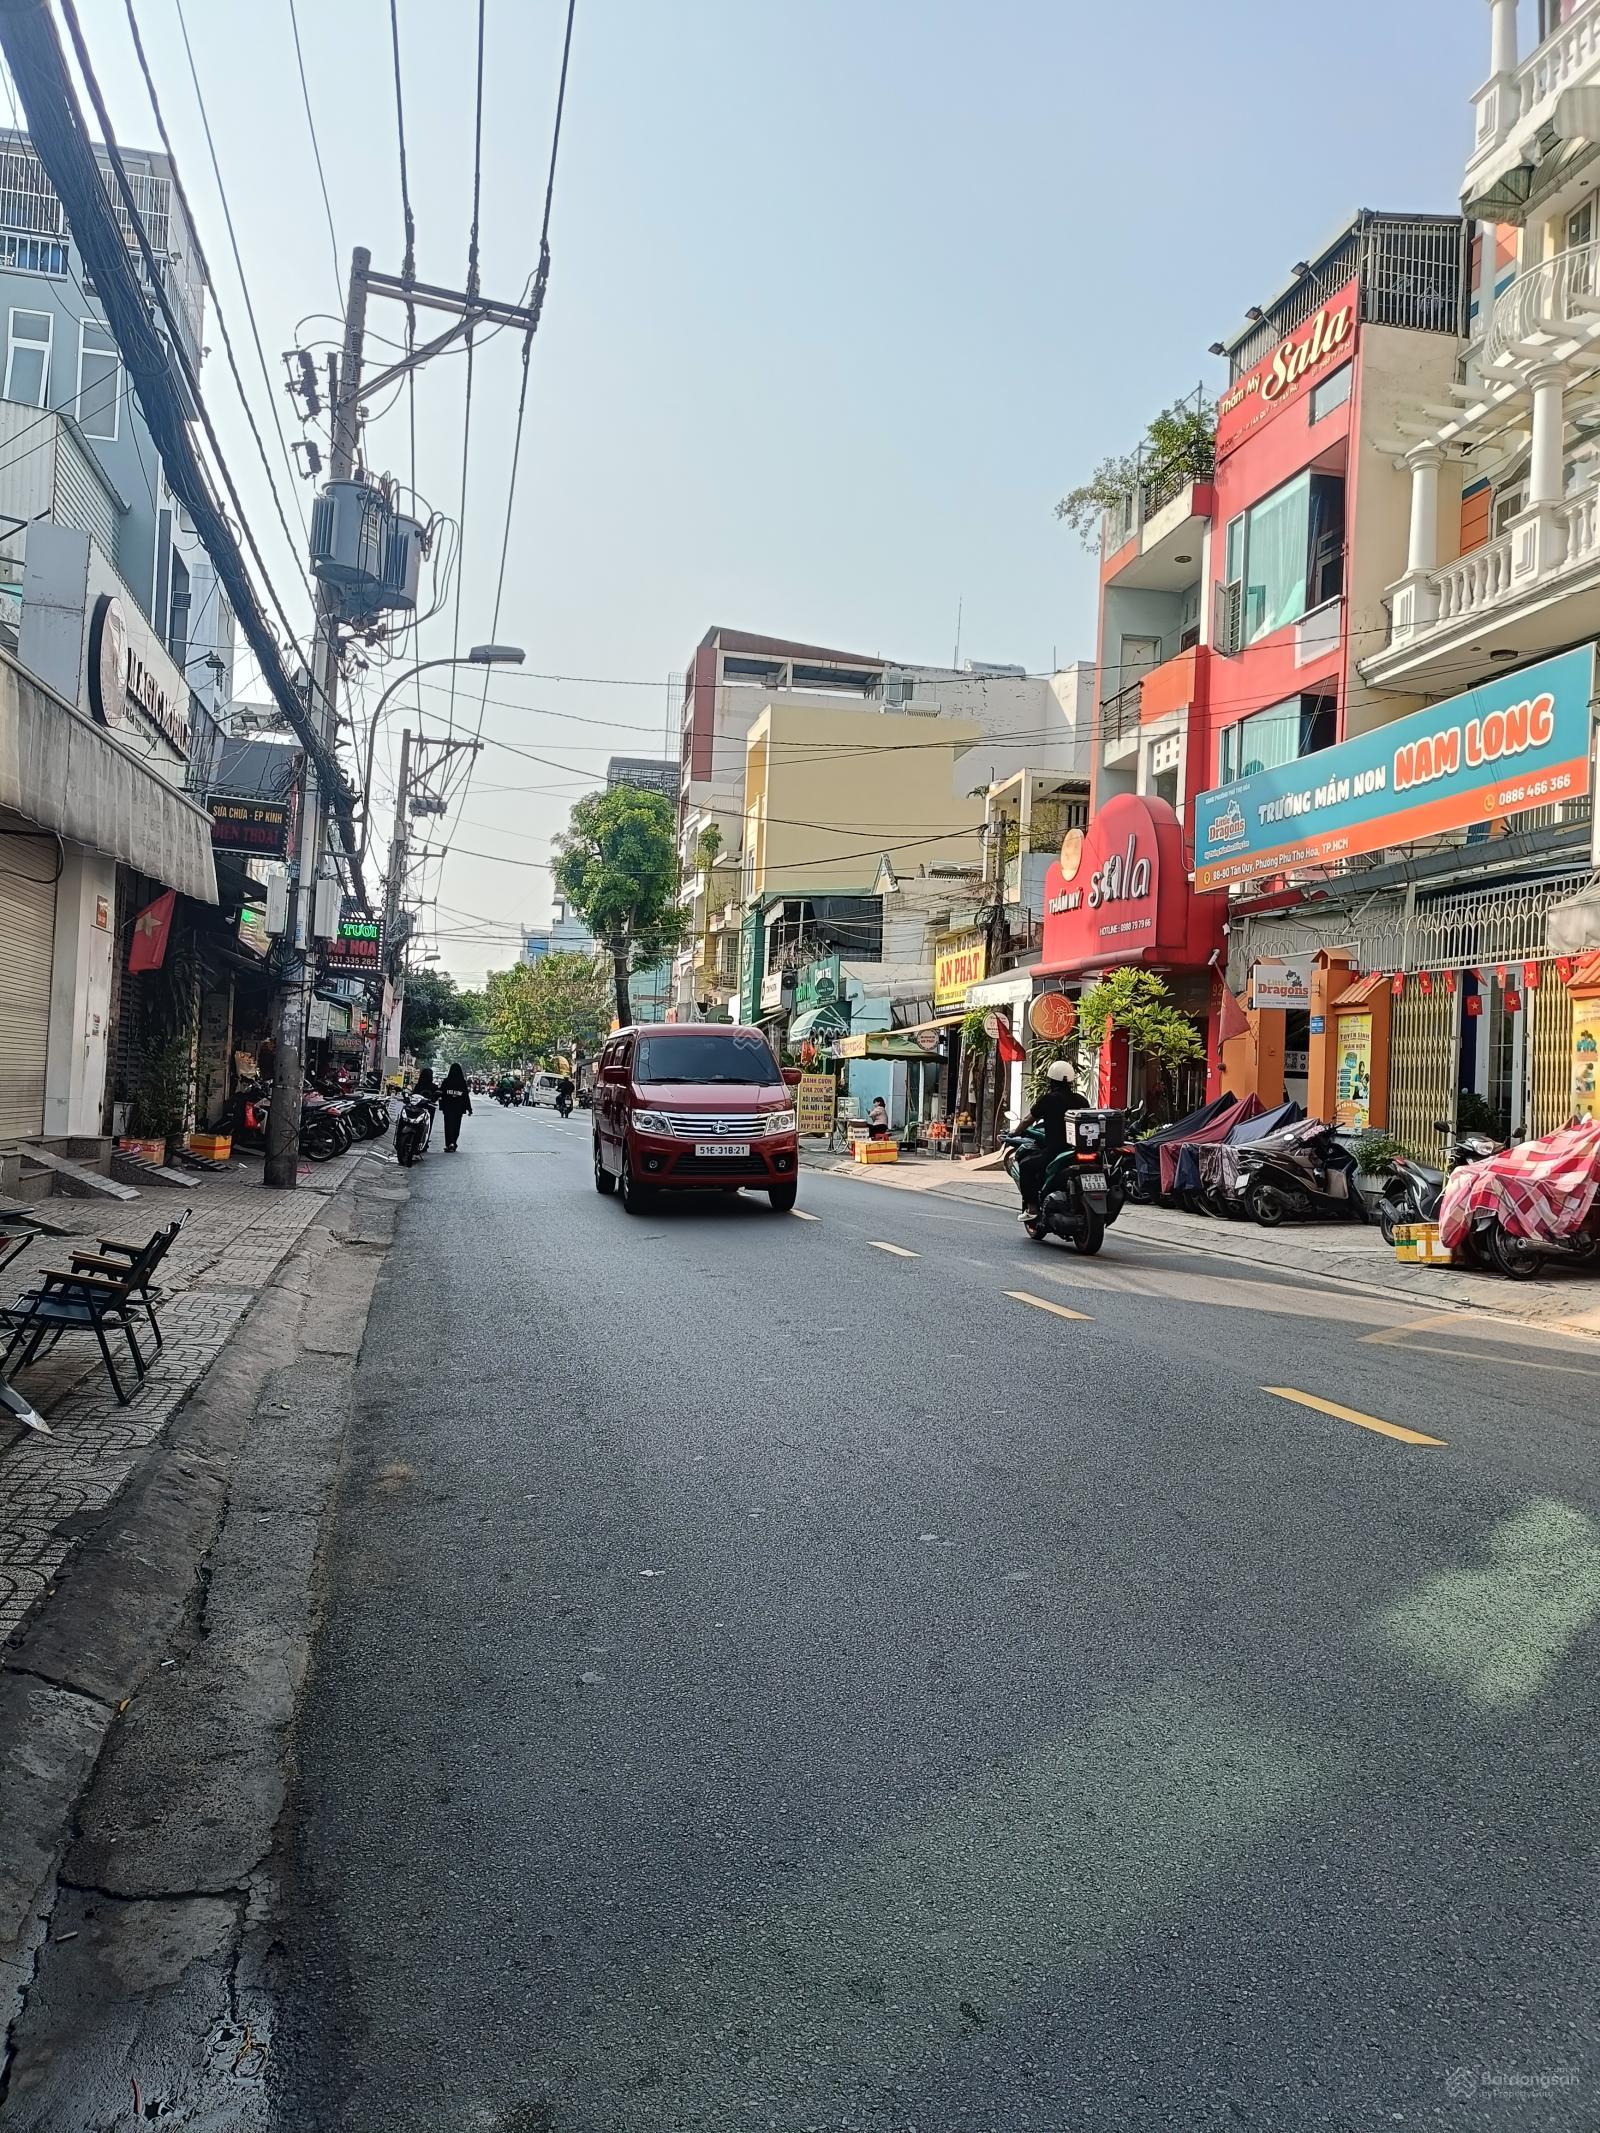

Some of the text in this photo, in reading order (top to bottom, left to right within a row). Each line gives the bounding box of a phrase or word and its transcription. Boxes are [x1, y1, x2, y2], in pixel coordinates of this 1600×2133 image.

[1221, 386, 1244, 415] Thẩm
[1262, 305, 1350, 401] Sala
[1258, 694, 1554, 825] TRƯỜNG MẦM NON NAM LONG
[1499, 774, 1571, 806] 0886 466 366
[254, 808, 264, 822] ÉP
[265, 810, 283, 824] KÍNH
[1209, 820, 1245, 839] Dragons
[1279, 853, 1292, 865] Phú
[1292, 850, 1304, 862] Thọ
[1322, 838, 1348, 853] TP.HCM
[1048, 888, 1068, 914] THẨM
[344, 923, 378, 938] TƯƠI
[350, 940, 377, 956] HOA
[345, 956, 360, 964] 335
[940, 960, 953, 987] AN
[1212, 984, 1223, 997] 92
[1257, 983, 1309, 997] Dragons
